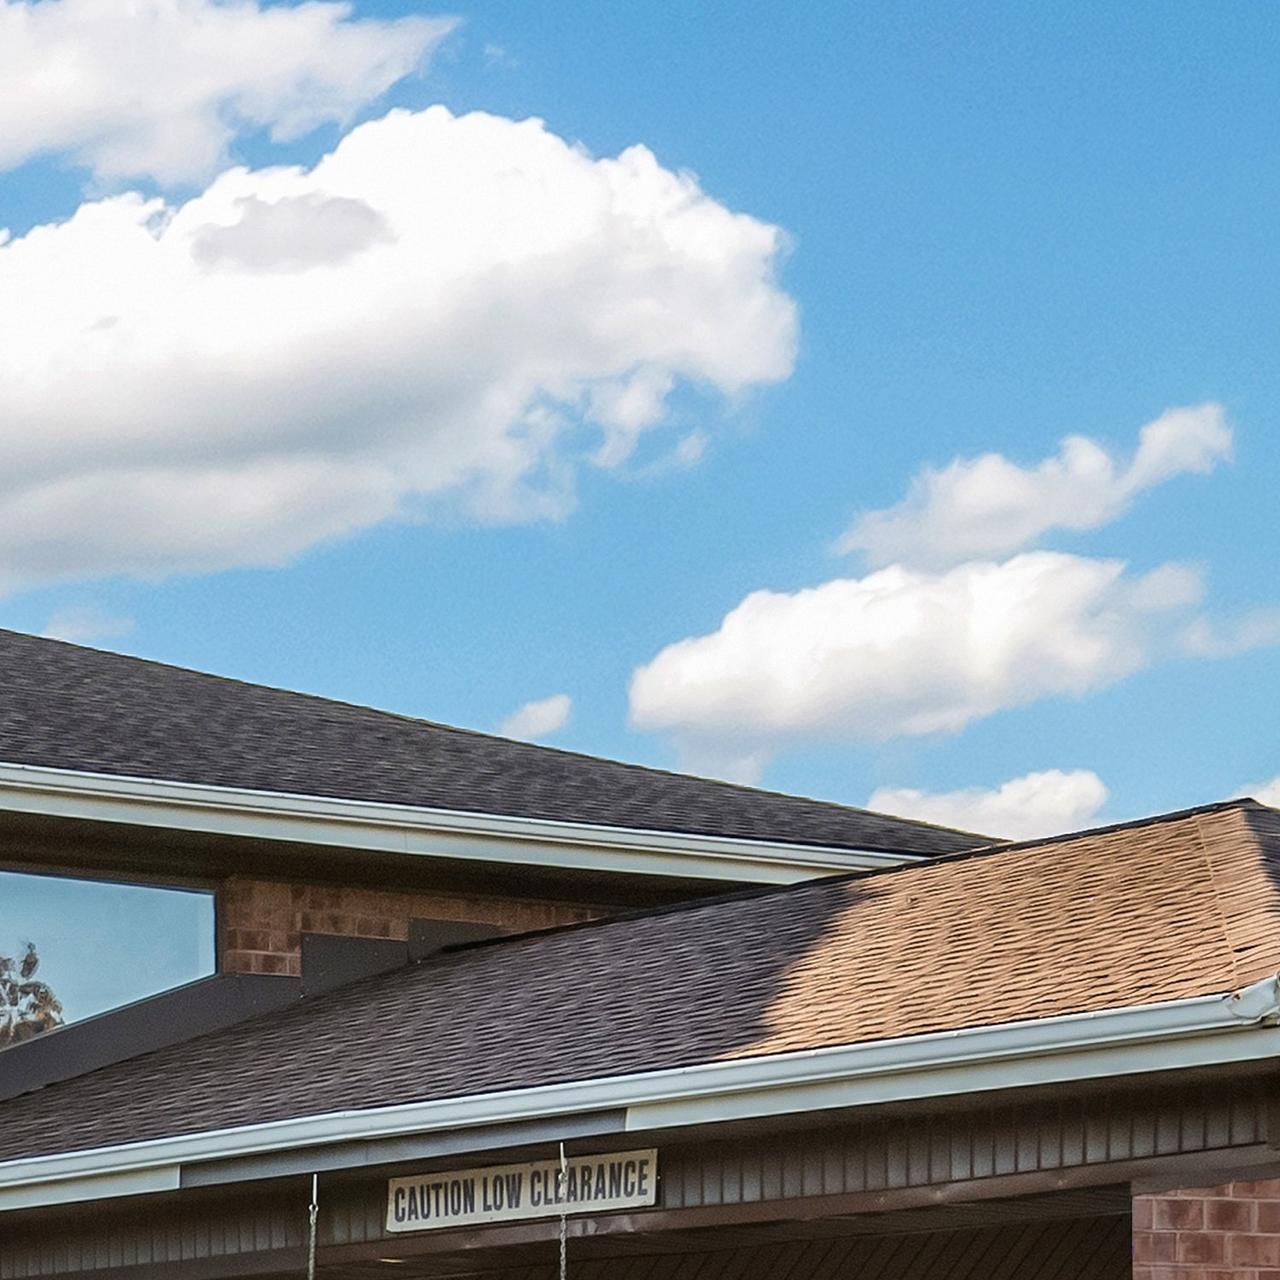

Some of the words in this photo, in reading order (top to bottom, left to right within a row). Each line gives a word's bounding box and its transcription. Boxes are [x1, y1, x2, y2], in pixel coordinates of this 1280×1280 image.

[394, 1178, 476, 1223] CAUTION
[482, 1173, 523, 1212] LOW
[530, 1159, 650, 1207] CLEARANCE
